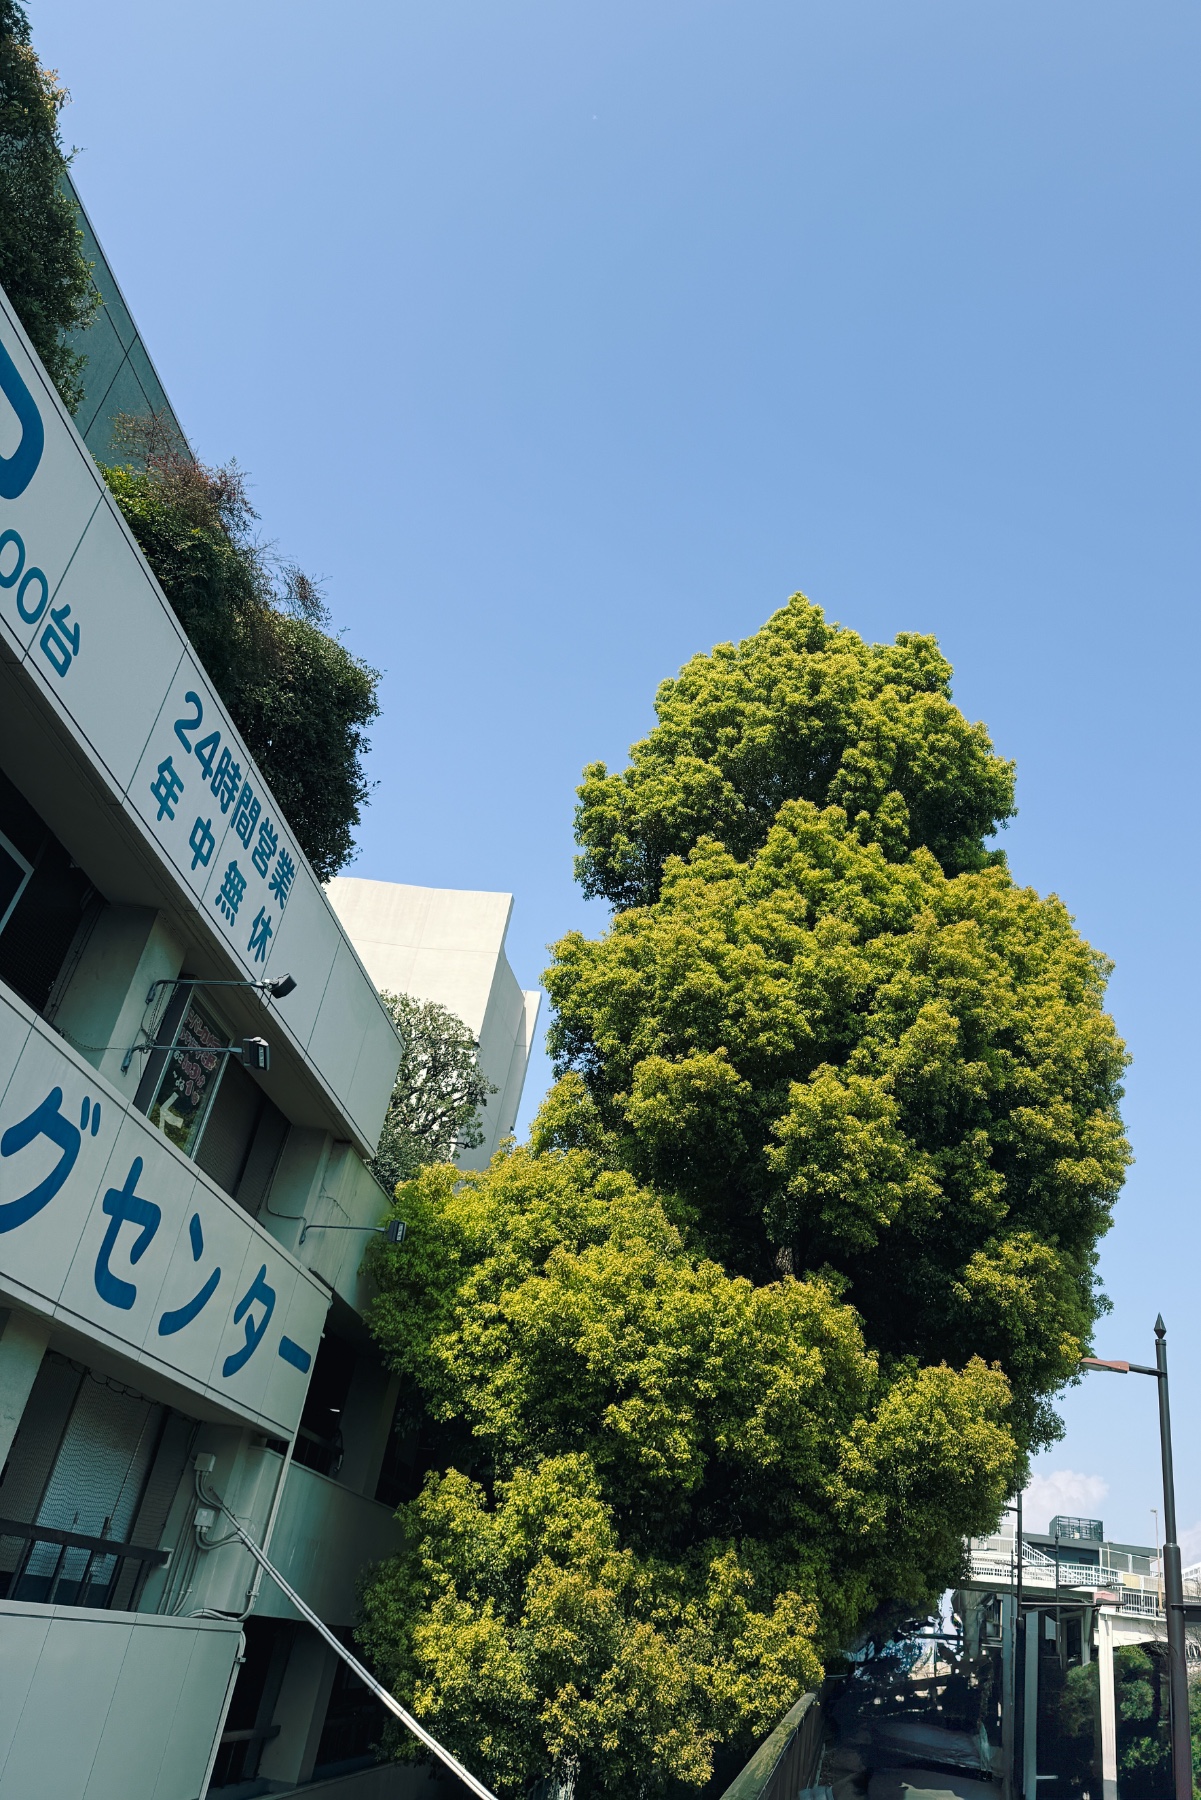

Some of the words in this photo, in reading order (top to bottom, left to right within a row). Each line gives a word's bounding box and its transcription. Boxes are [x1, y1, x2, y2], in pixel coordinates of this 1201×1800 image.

[150, 756, 272, 963] 年中無休
[174, 691, 295, 910] 24時間営業
[0, 1086, 312, 1378] グセンター
